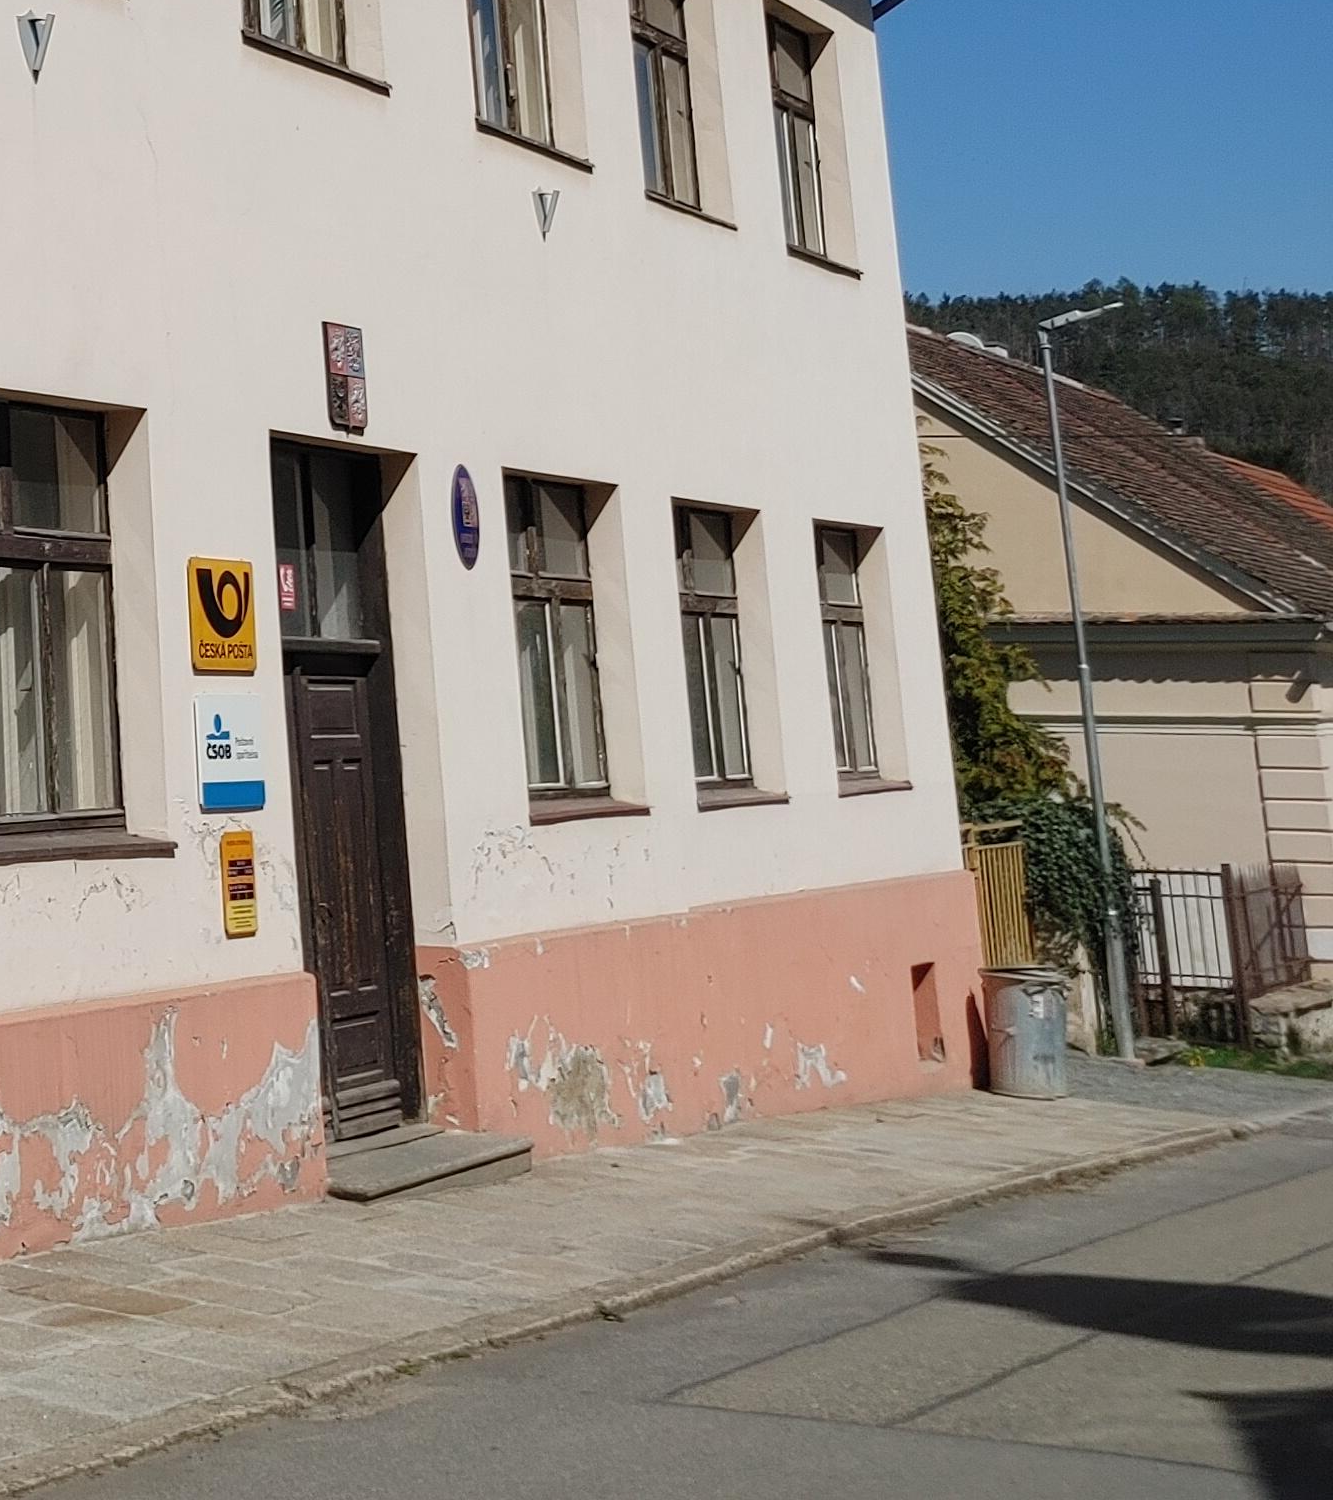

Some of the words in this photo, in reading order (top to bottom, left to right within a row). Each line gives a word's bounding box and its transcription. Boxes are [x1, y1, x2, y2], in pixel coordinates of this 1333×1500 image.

[198, 639, 226, 659] ČESKÁ
[227, 641, 253, 659] POŠTA
[206, 742, 232, 760] ČSOB
